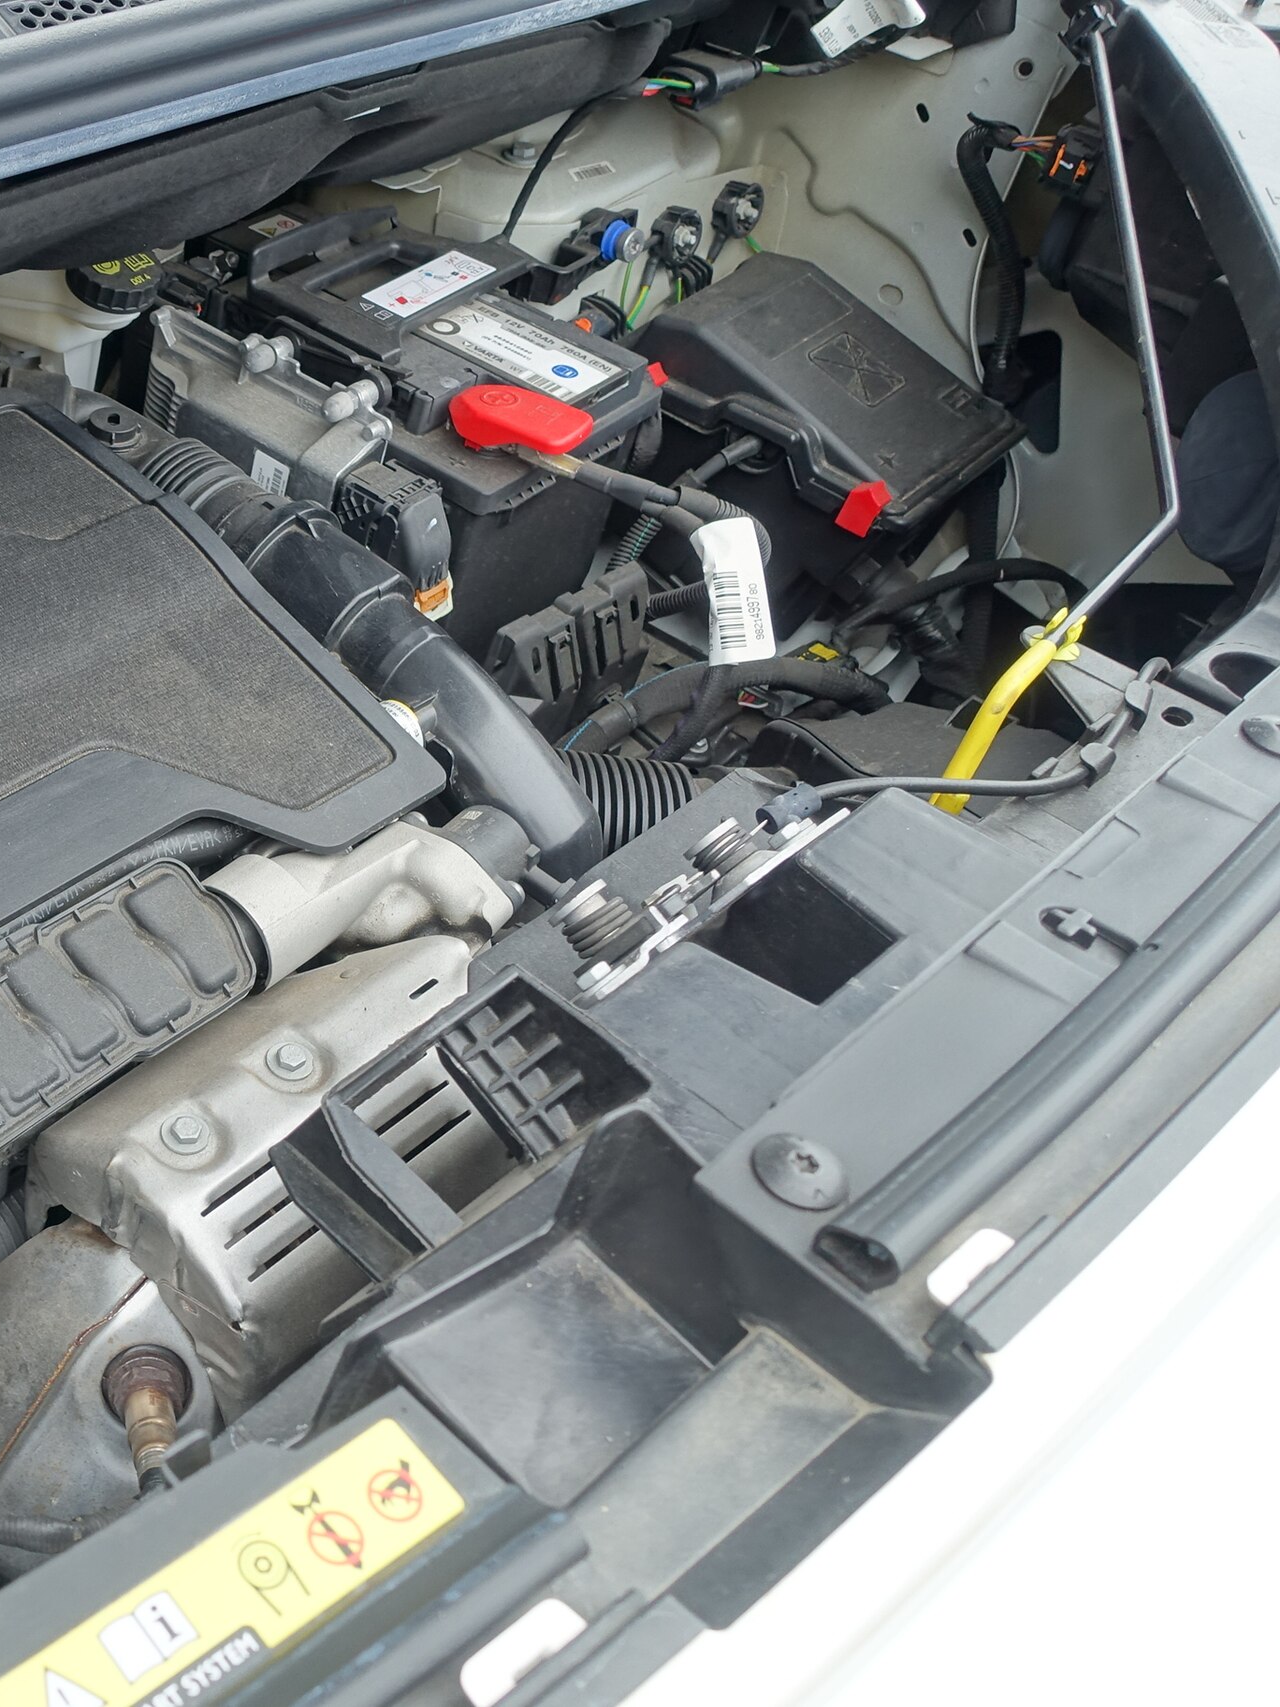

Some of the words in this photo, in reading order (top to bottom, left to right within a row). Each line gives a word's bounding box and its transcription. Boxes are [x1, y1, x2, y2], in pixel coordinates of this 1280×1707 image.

[129, 274, 144, 285] DOT
[471, 344, 504, 363] VARTA
[504, 317, 525, 330] 12V
[527, 328, 556, 345] 70Ah
[559, 344, 587, 360] 760A
[587, 357, 612, 373] (EN)
[180, 1631, 260, 1697] SYSTEM
